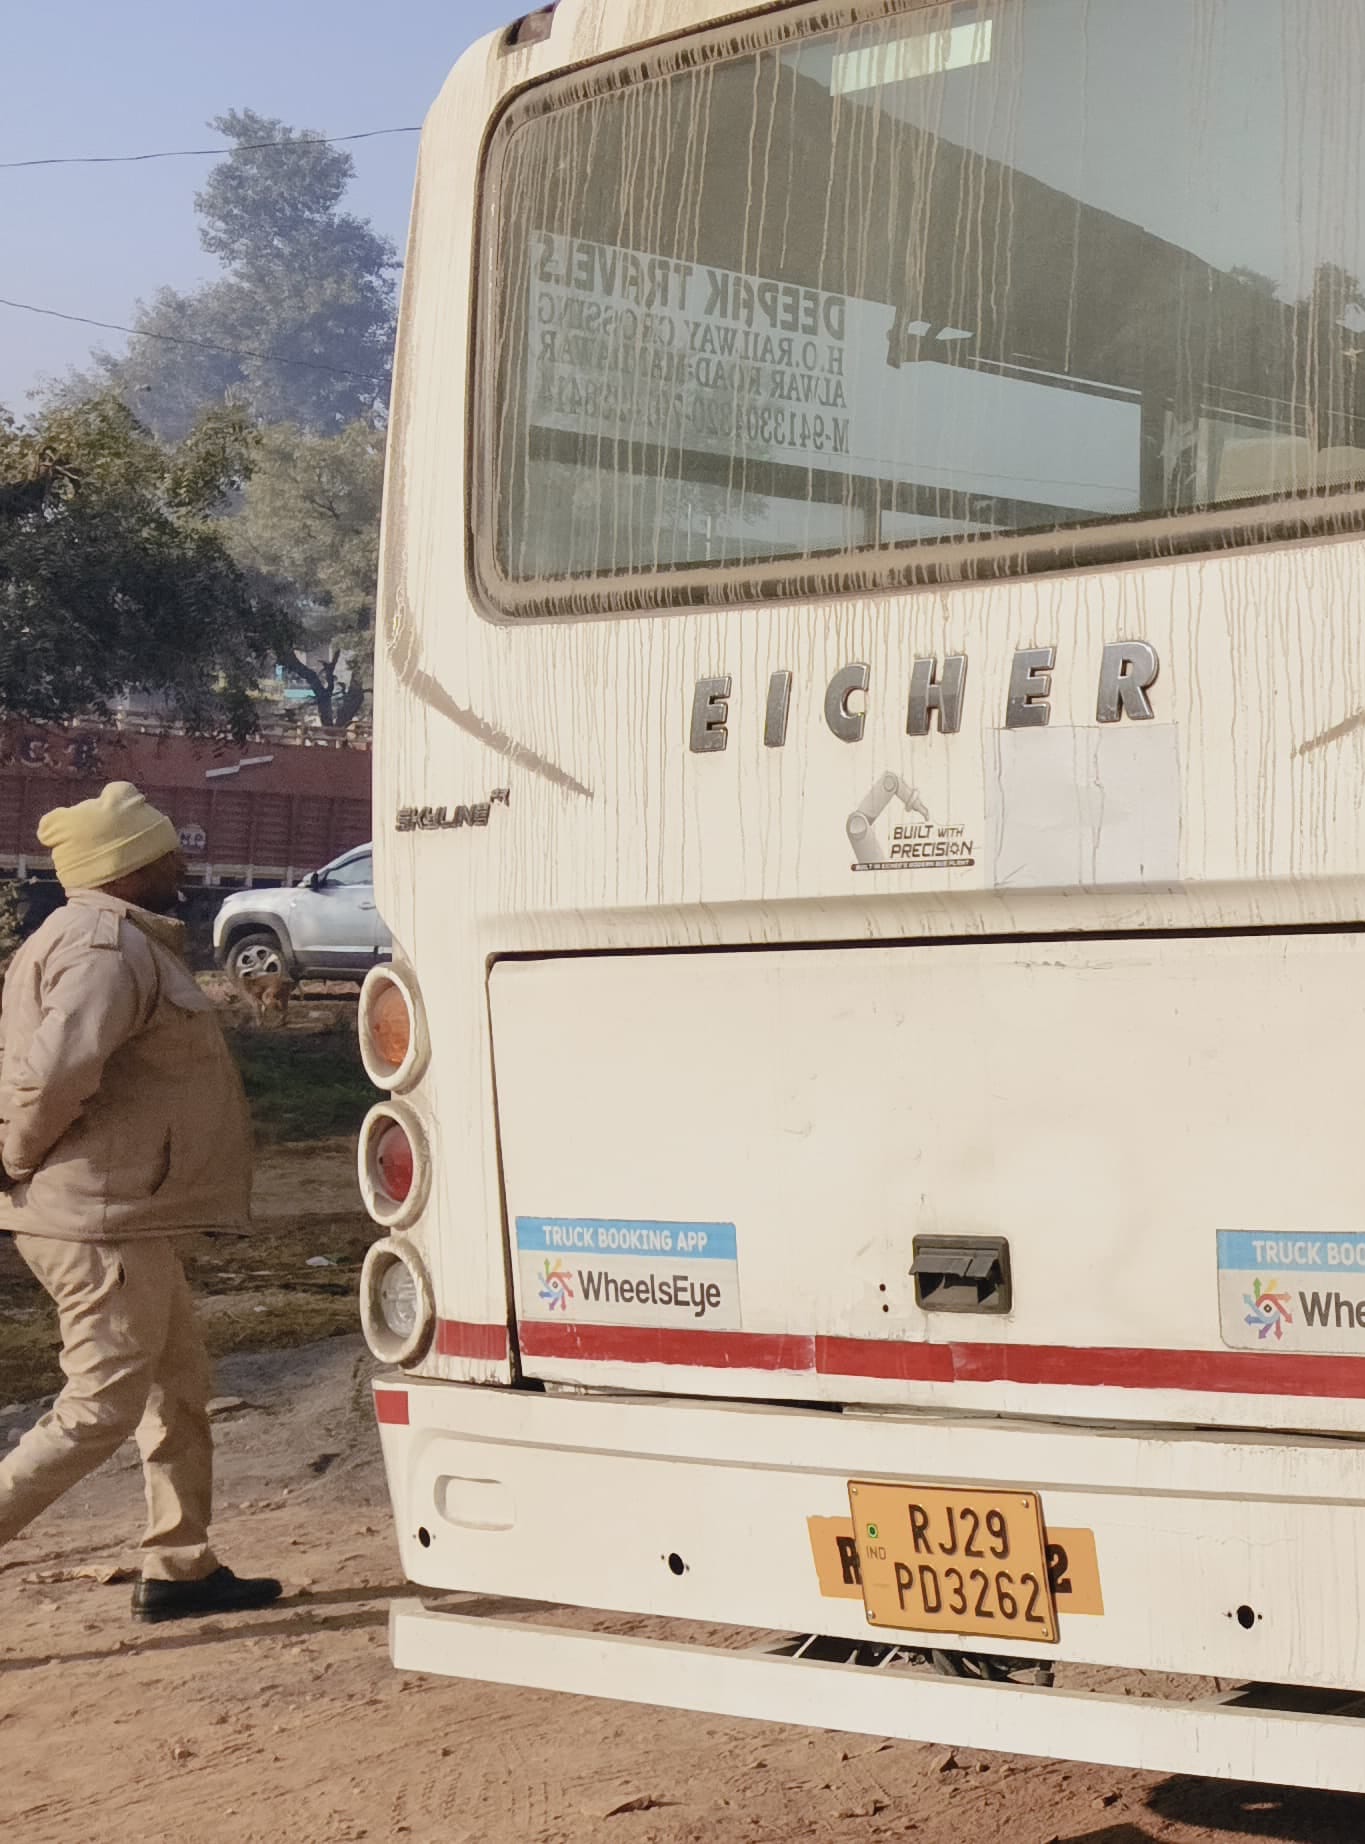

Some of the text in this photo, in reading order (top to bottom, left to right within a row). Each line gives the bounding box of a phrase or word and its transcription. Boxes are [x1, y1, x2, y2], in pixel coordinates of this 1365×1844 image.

[689, 640, 1160, 754] EICHER
[395, 802, 491, 832] SKYLINE
[893, 825, 964, 840] BUILT WITH
[890, 840, 974, 858] PRECISION
[542, 1226, 707, 1252] TRUCK BOOKING APP
[1252, 1240, 1321, 1265] TRUCK
[578, 1270, 721, 1317] WheelsEye
[908, 1503, 1010, 1559] RJ29
[866, 1545, 887, 1561] IND
[894, 1561, 1046, 1623] PD3262
